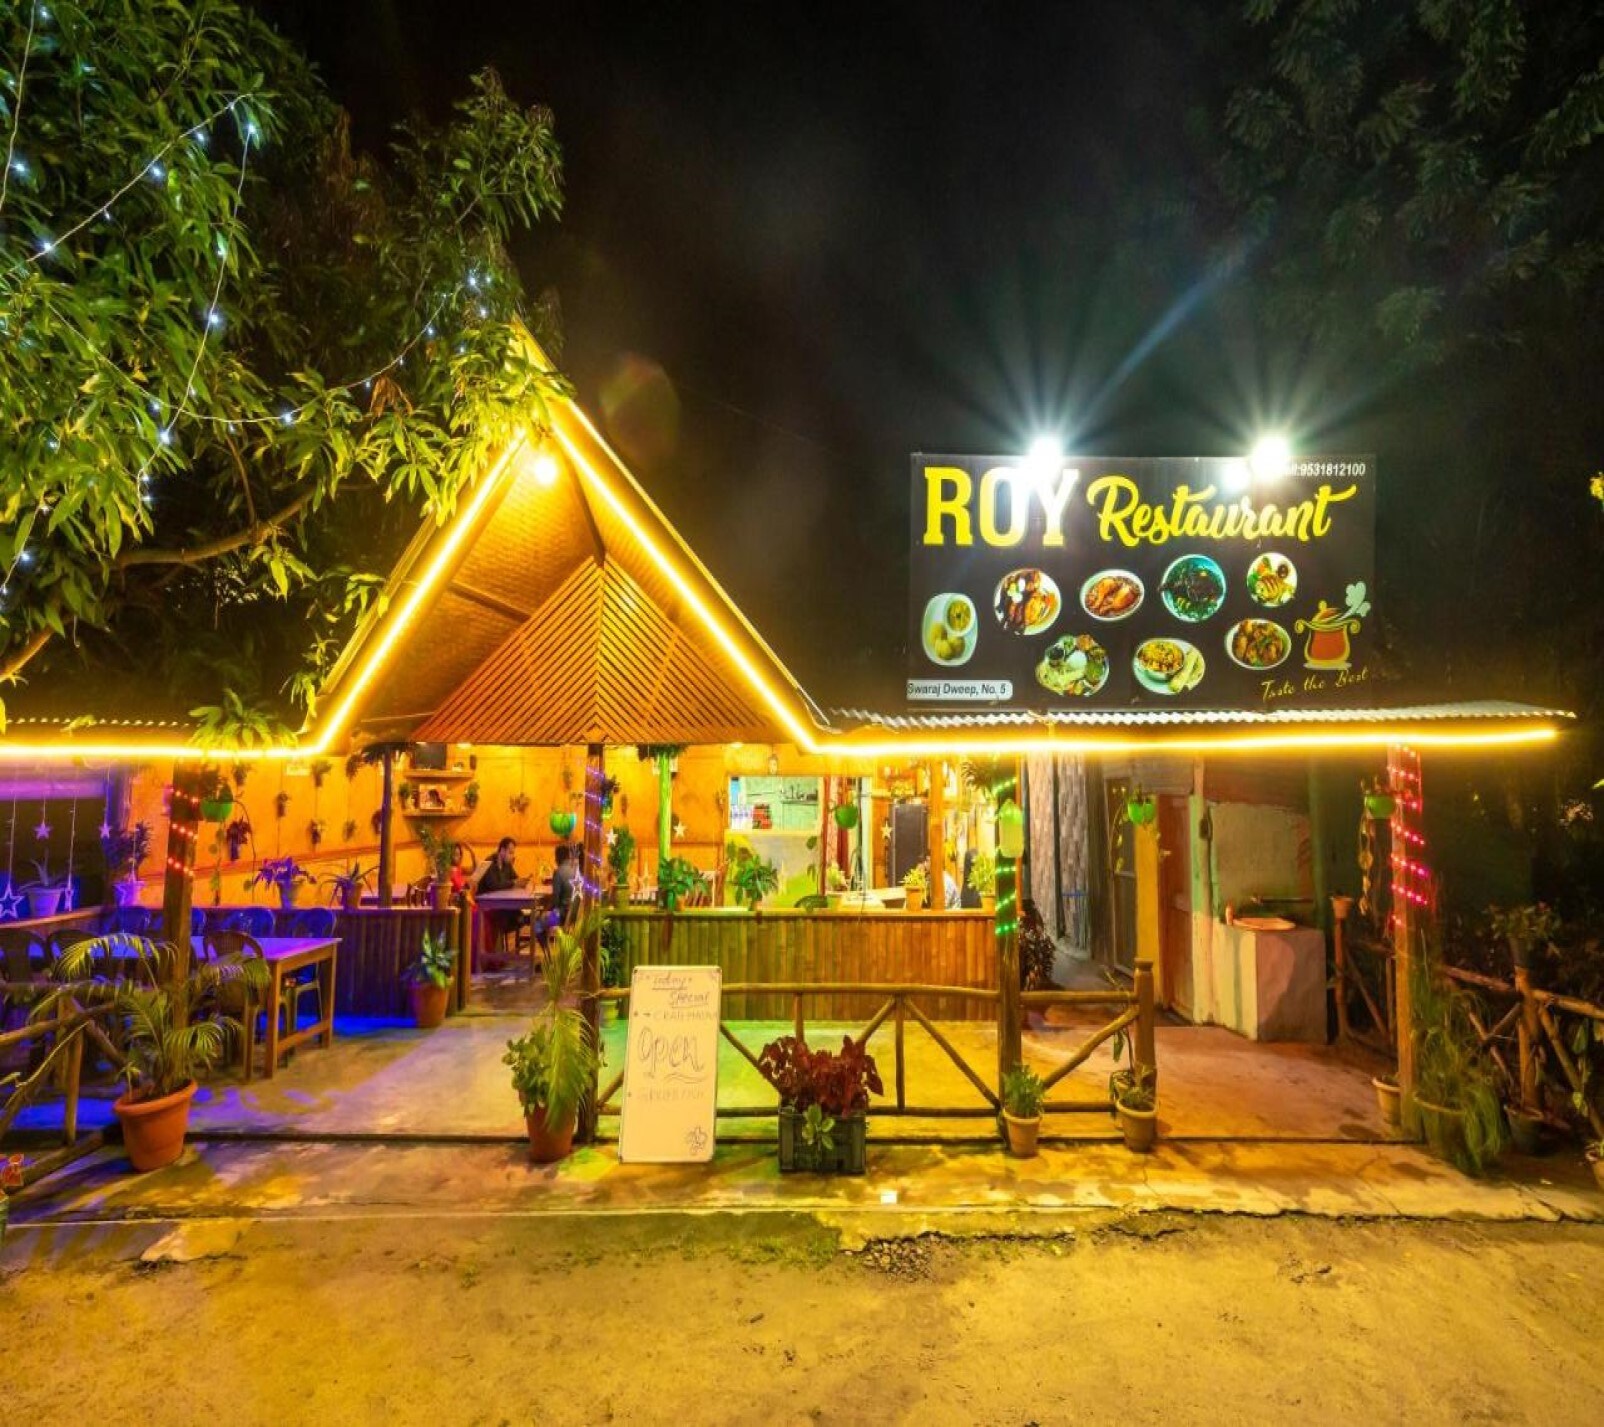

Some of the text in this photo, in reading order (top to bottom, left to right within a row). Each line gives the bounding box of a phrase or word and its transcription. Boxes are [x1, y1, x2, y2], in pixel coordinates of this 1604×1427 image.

[923, 466, 1357, 547] ROY Restaurant
[906, 682, 941, 697] Swaraj
[943, 682, 979, 697] Dweep,
[1000, 683, 1006, 694] 5
[1261, 666, 1368, 703] Taste the Best
